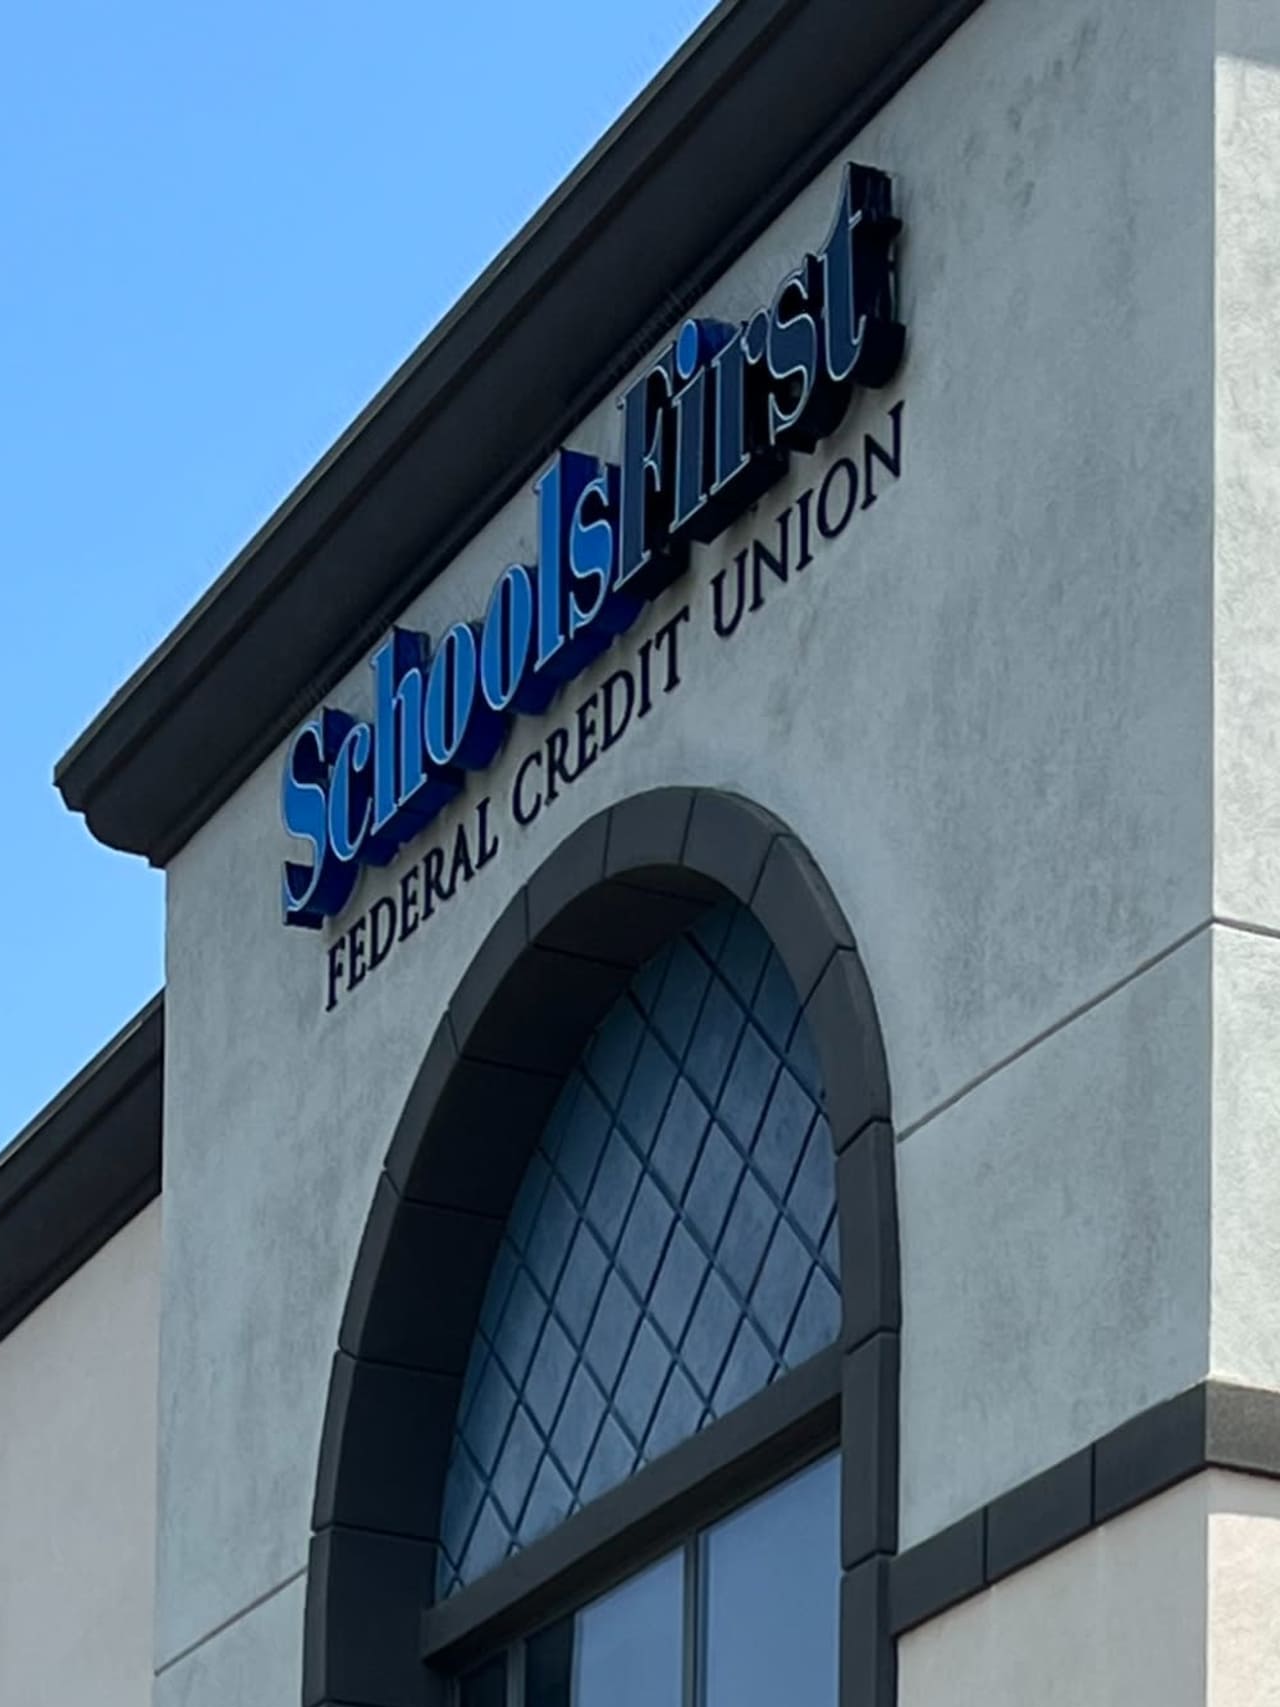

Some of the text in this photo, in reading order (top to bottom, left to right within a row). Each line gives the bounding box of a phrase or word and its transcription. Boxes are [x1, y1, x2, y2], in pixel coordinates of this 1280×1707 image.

[282, 161, 907, 927] SchoolsFirst
[324, 401, 905, 1012] FEDERAL CREDIT UNION
